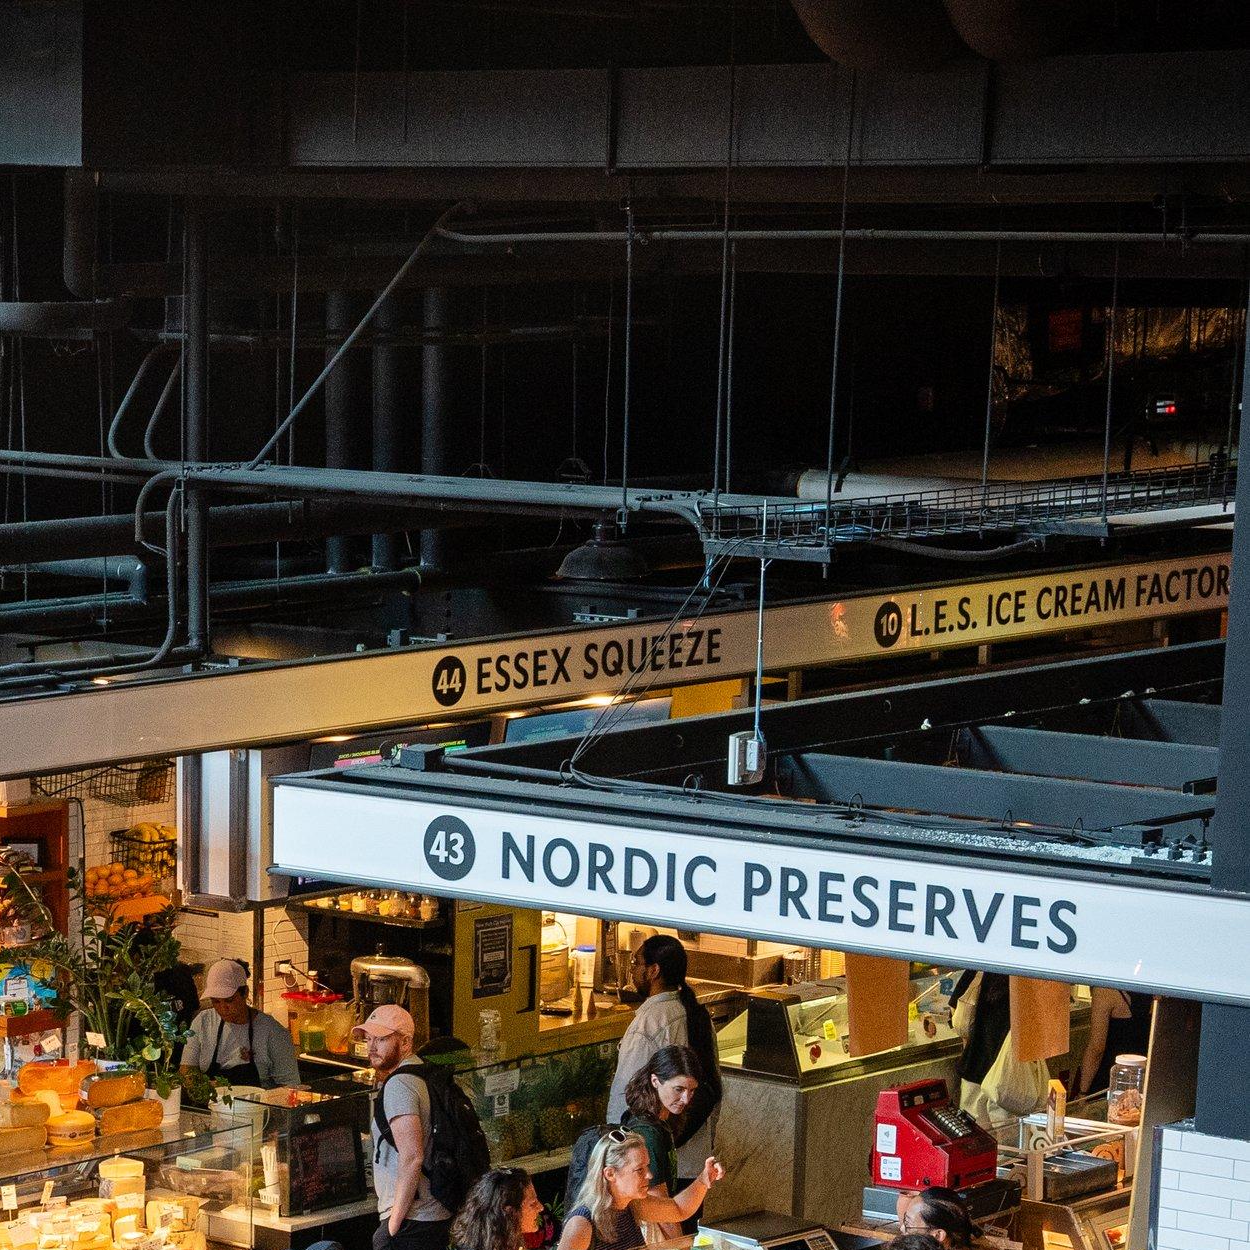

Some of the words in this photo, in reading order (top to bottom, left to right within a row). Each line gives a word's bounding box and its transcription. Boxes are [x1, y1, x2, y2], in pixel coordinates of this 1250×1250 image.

[880, 613, 897, 636] 10
[910, 597, 977, 637] L.E.S.
[987, 590, 1026, 626] ICE
[1036, 578, 1126, 620] CREAM
[436, 668, 462, 694] 44
[477, 646, 571, 694] ESSEX
[583, 628, 721, 680] SQUEEZE
[429, 830, 465, 866] 43
[501, 832, 717, 906] NORDIC
[743, 862, 1078, 954] PRESERVES
